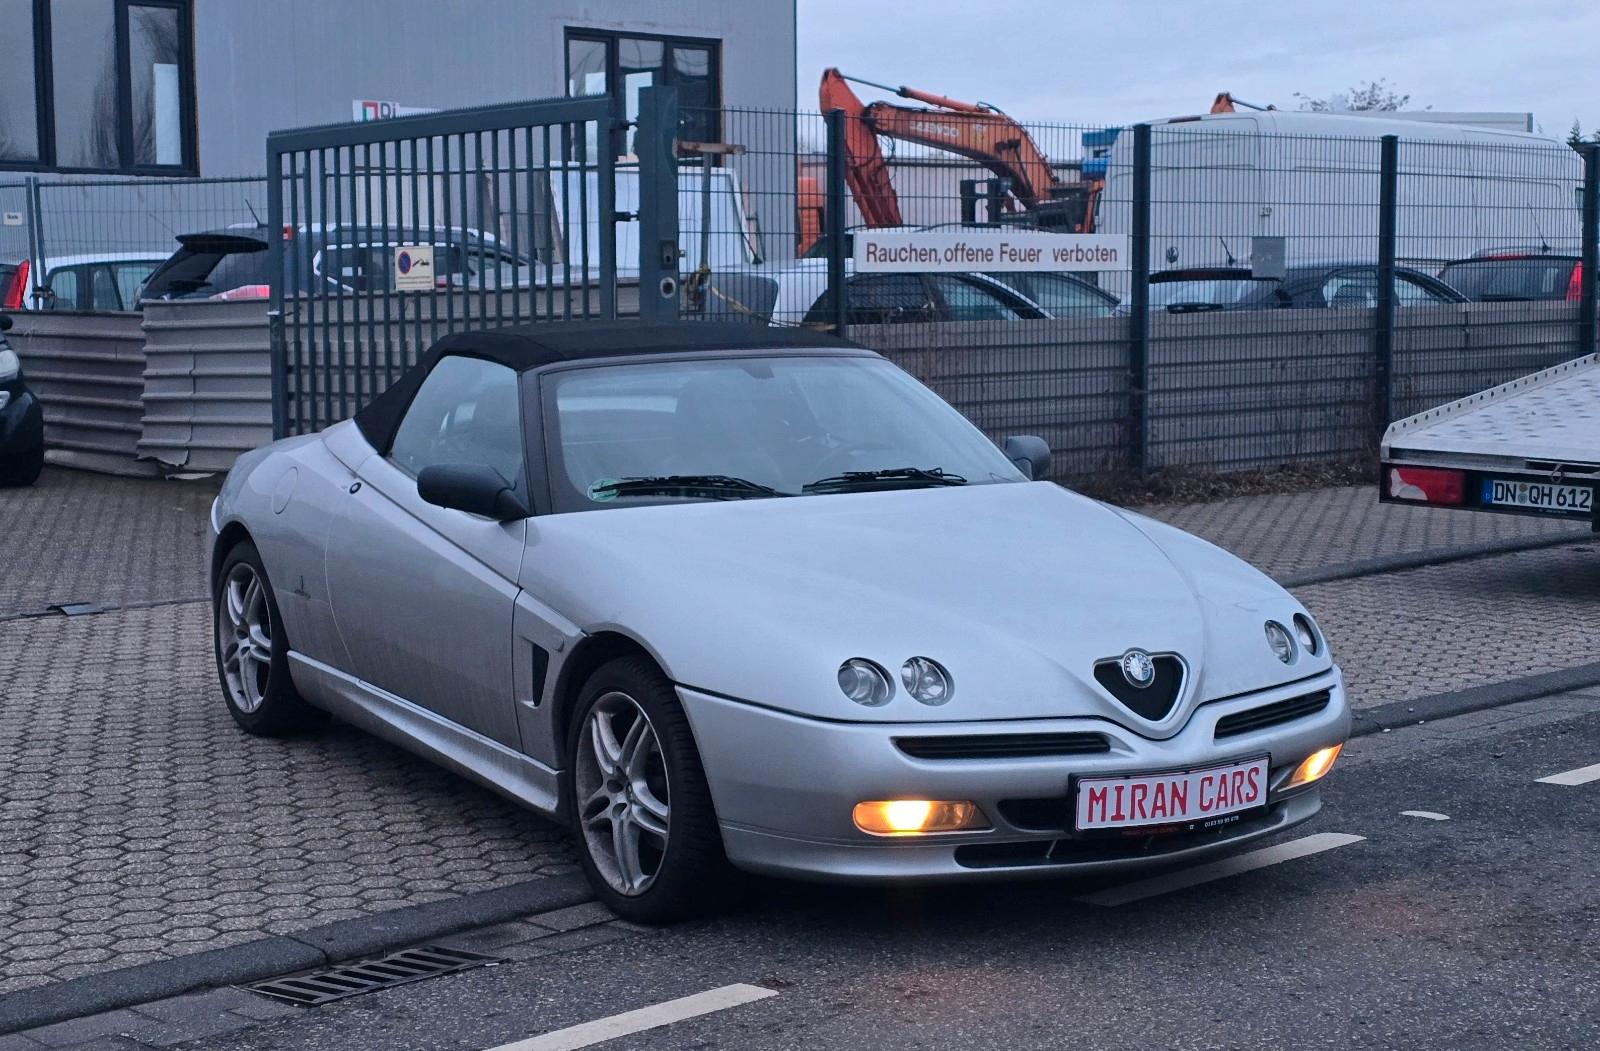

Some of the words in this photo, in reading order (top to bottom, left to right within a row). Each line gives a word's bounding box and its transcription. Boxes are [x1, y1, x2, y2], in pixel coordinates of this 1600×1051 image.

[866, 242, 941, 265] Rauchen,
[944, 242, 994, 263] offene
[1000, 242, 1042, 263] Feuer
[1052, 243, 1118, 263] verboten
[1494, 482, 1517, 503] DN
[1088, 780, 1188, 823] MIRAN
[1199, 766, 1260, 812] CARS
